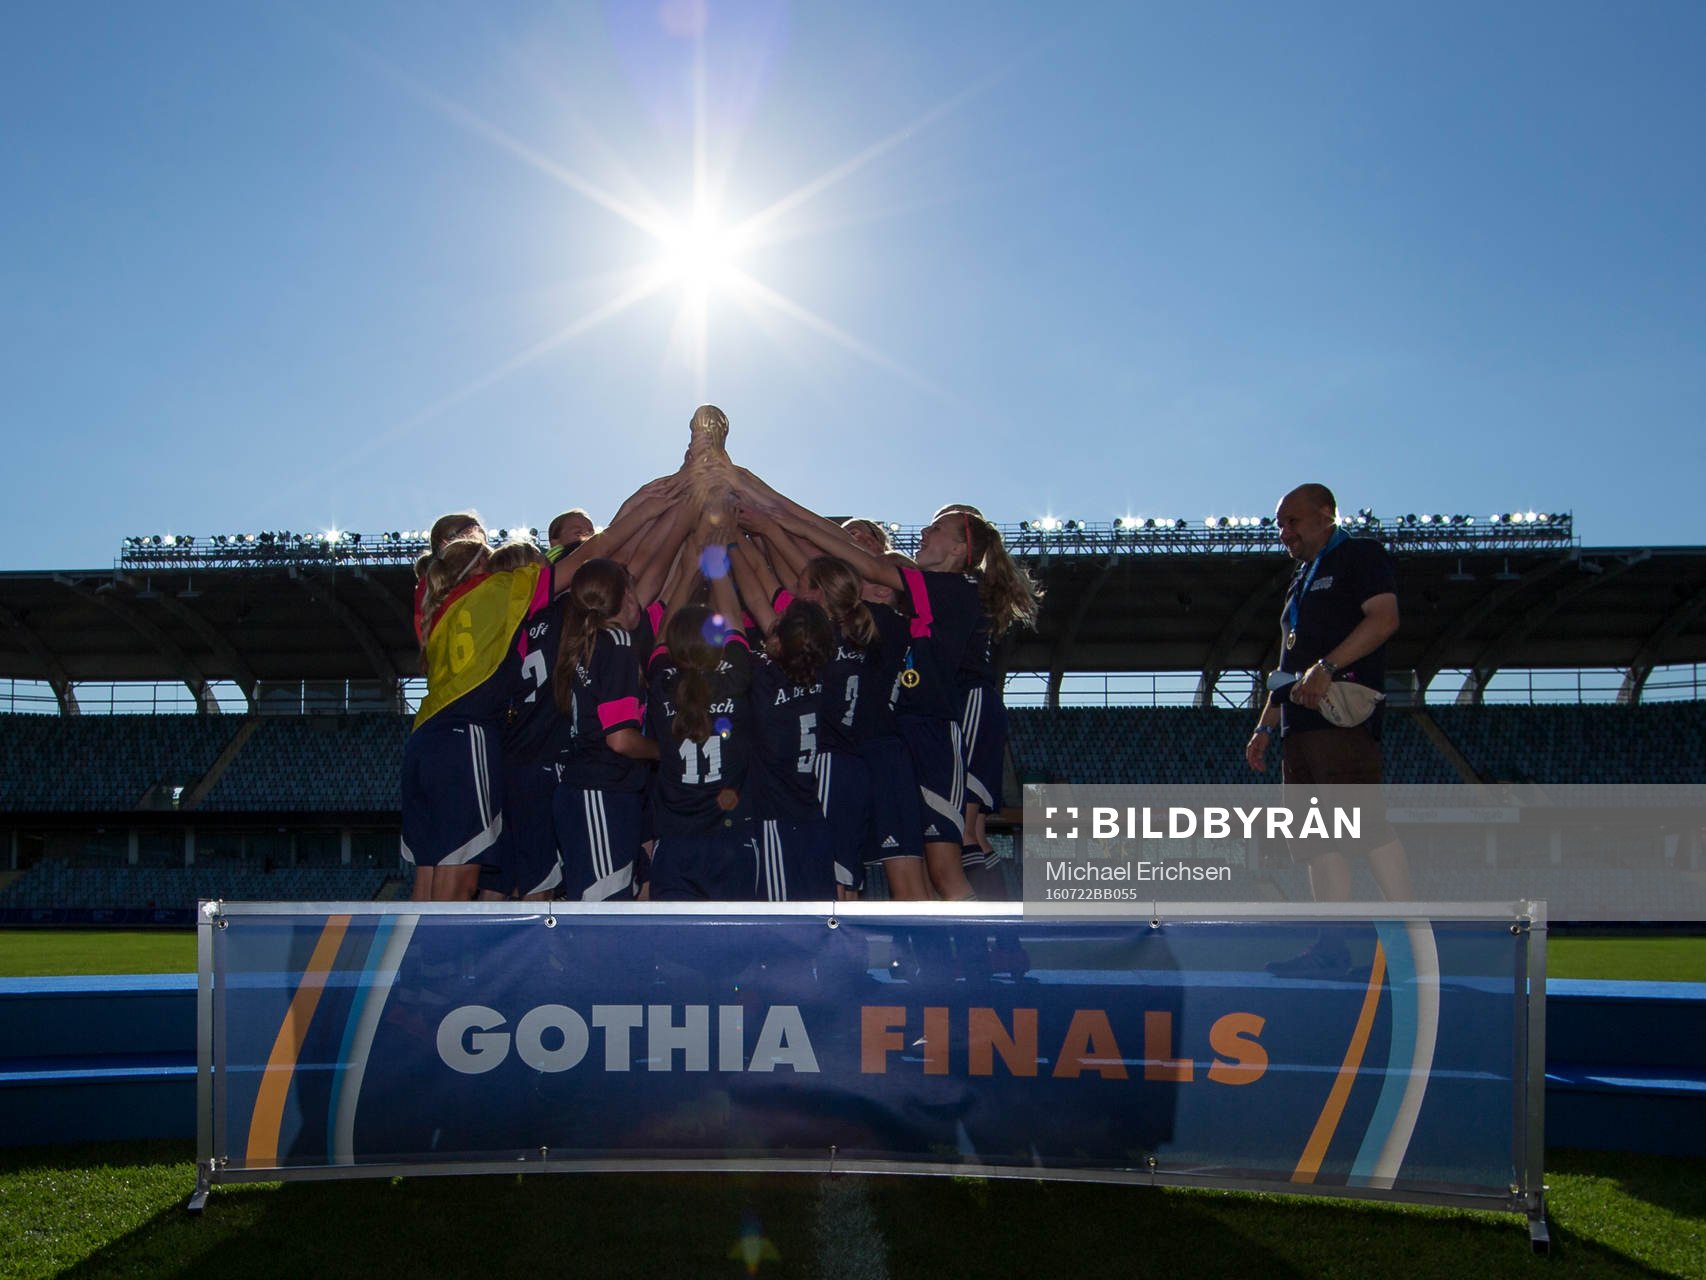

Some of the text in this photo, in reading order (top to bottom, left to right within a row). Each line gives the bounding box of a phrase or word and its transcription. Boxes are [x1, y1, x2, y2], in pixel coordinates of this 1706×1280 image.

[449, 610, 475, 673] 6
[678, 735, 722, 784] 11
[797, 712, 817, 773] 5
[436, 1003, 1269, 1086] GOTHIA FINALS
